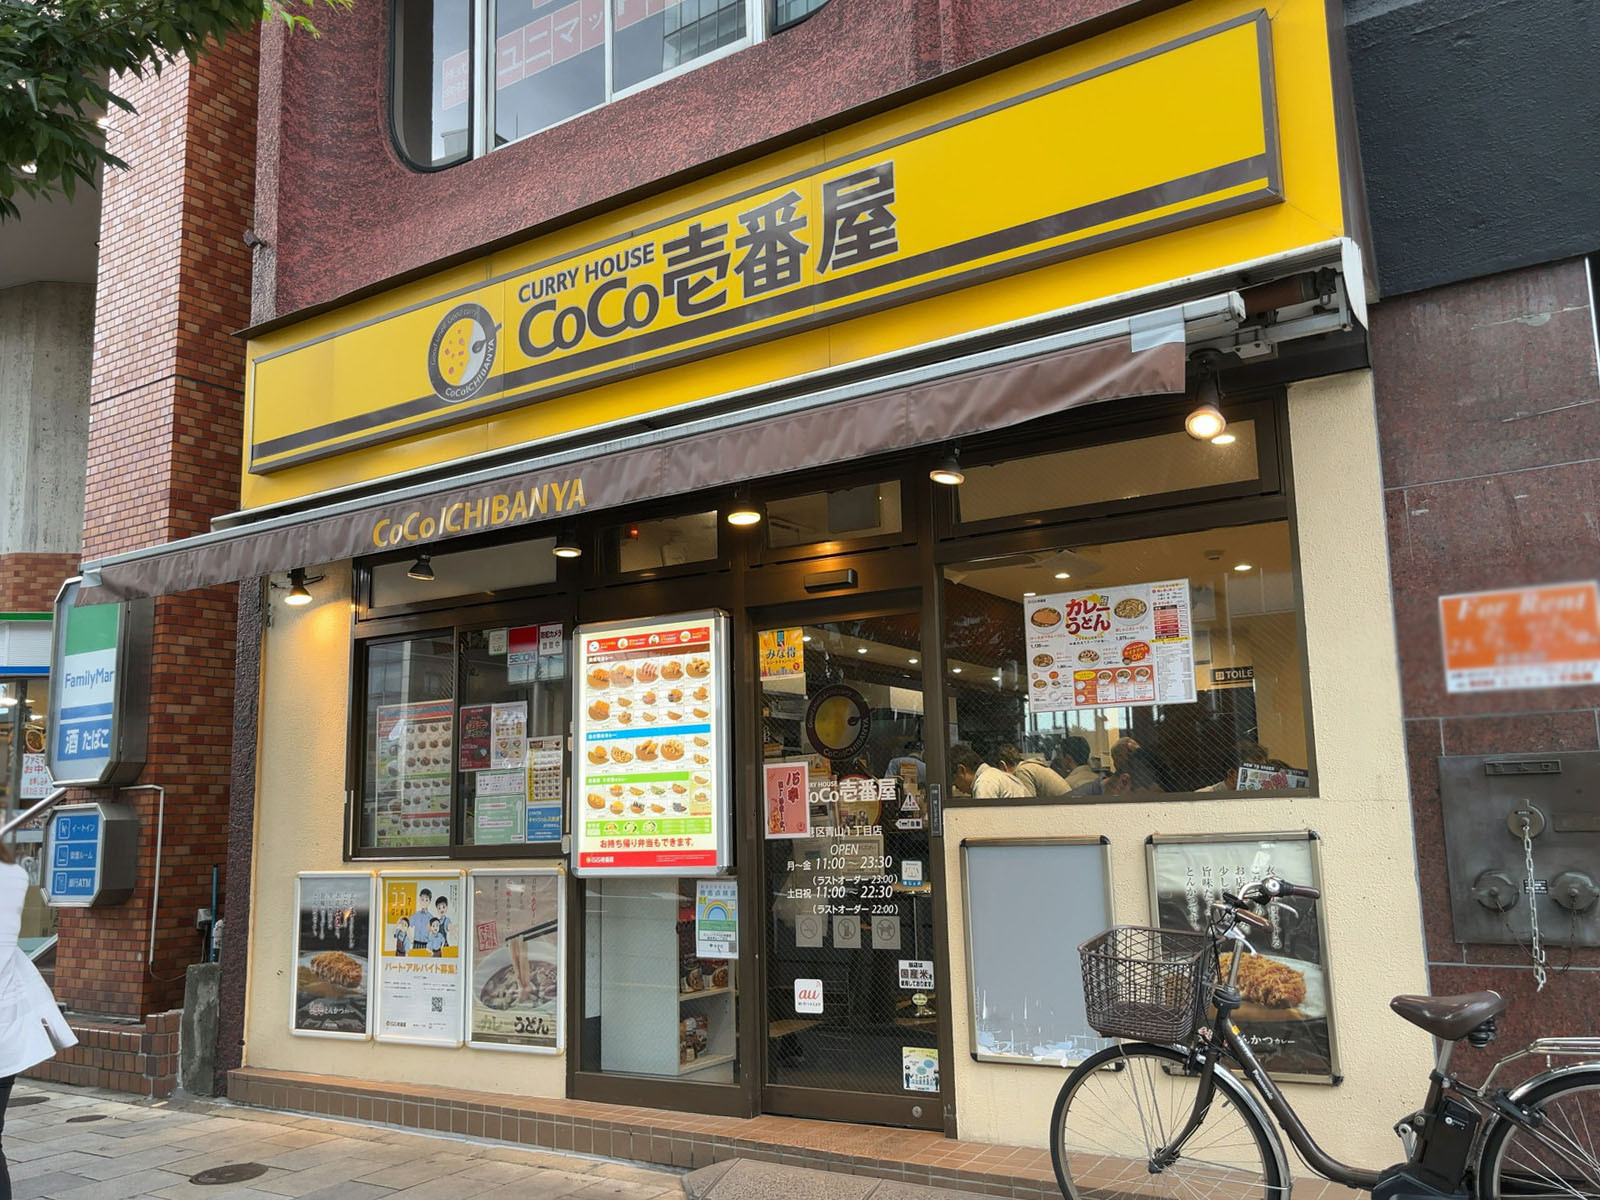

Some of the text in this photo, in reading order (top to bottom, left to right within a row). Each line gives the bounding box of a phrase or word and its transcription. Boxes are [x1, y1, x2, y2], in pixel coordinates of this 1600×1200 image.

[518, 159, 898, 358] CoCo壱番屋
[518, 242, 654, 303] CURRY HOUSE
[445, 338, 494, 397] CoCoICHIBANYA
[1065, 599, 1110, 617] カレー
[1065, 613, 1111, 635] うどん
[509, 652, 537, 663] SECOM
[65, 729, 109, 754] 酒 たばこ
[808, 778, 897, 803] oCo壱番屋
[830, 844, 859, 855] OPEN
[815, 857, 845, 870] 11:00
[860, 855, 893, 869] 23:30
[787, 888, 811, 899] 土日祝
[815, 886, 845, 899] 11:00
[860, 885, 893, 899] 22:30
[798, 988, 820, 1000] au
[514, 1015, 549, 1035] うどん
